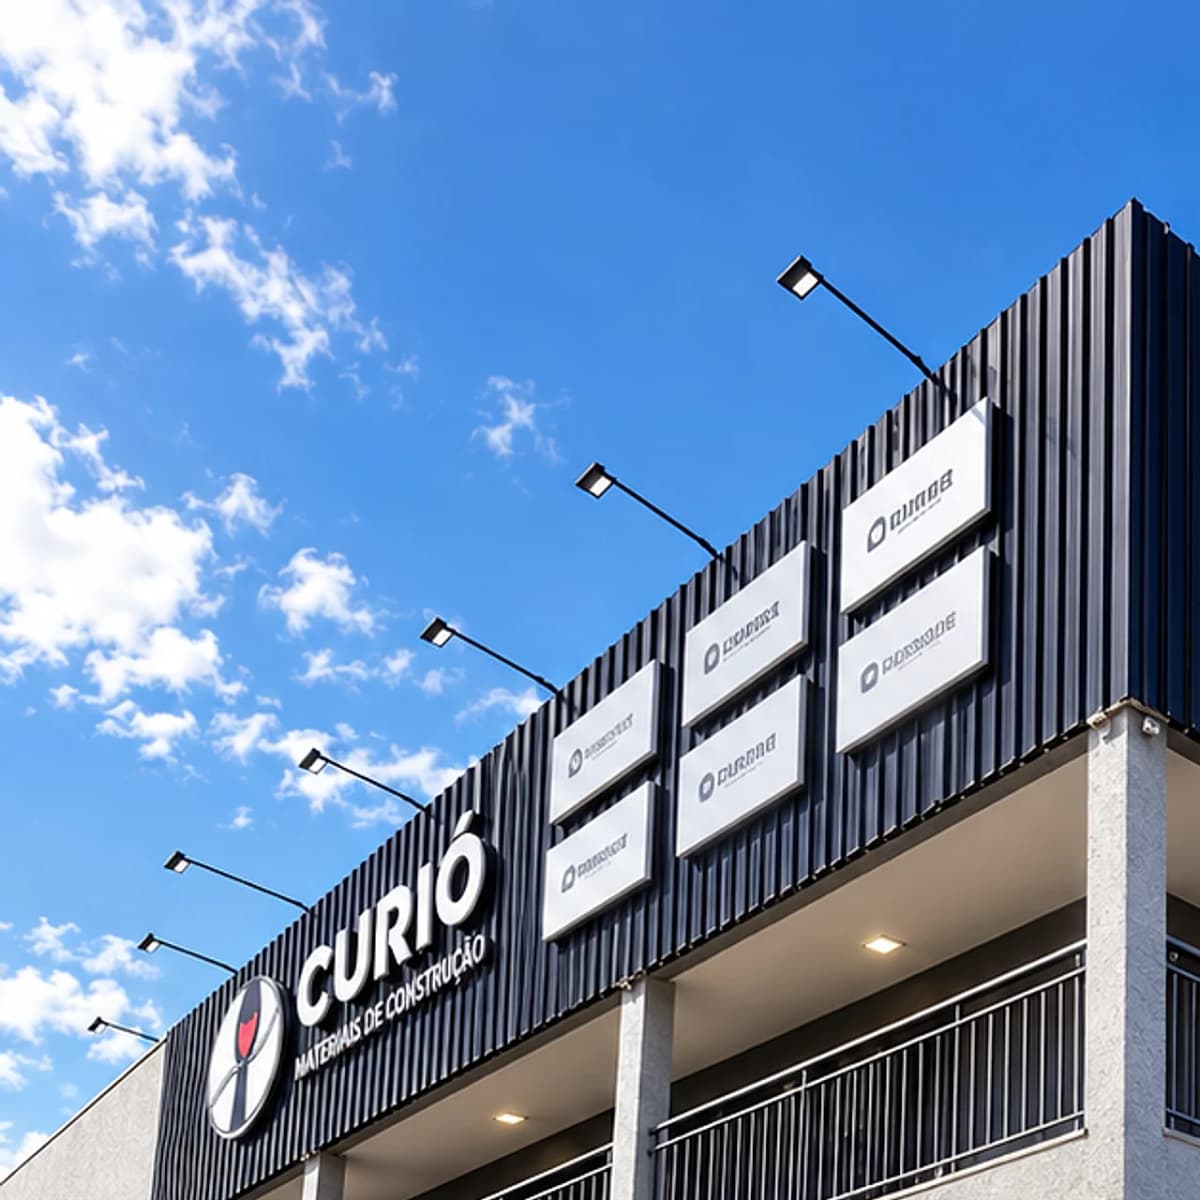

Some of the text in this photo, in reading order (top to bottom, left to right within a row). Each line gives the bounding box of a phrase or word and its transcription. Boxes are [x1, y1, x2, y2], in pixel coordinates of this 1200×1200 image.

[294, 934, 485, 1080] MATERIAIS DE CONSTRUÇÃO
[296, 810, 486, 1026] CURIÓ
